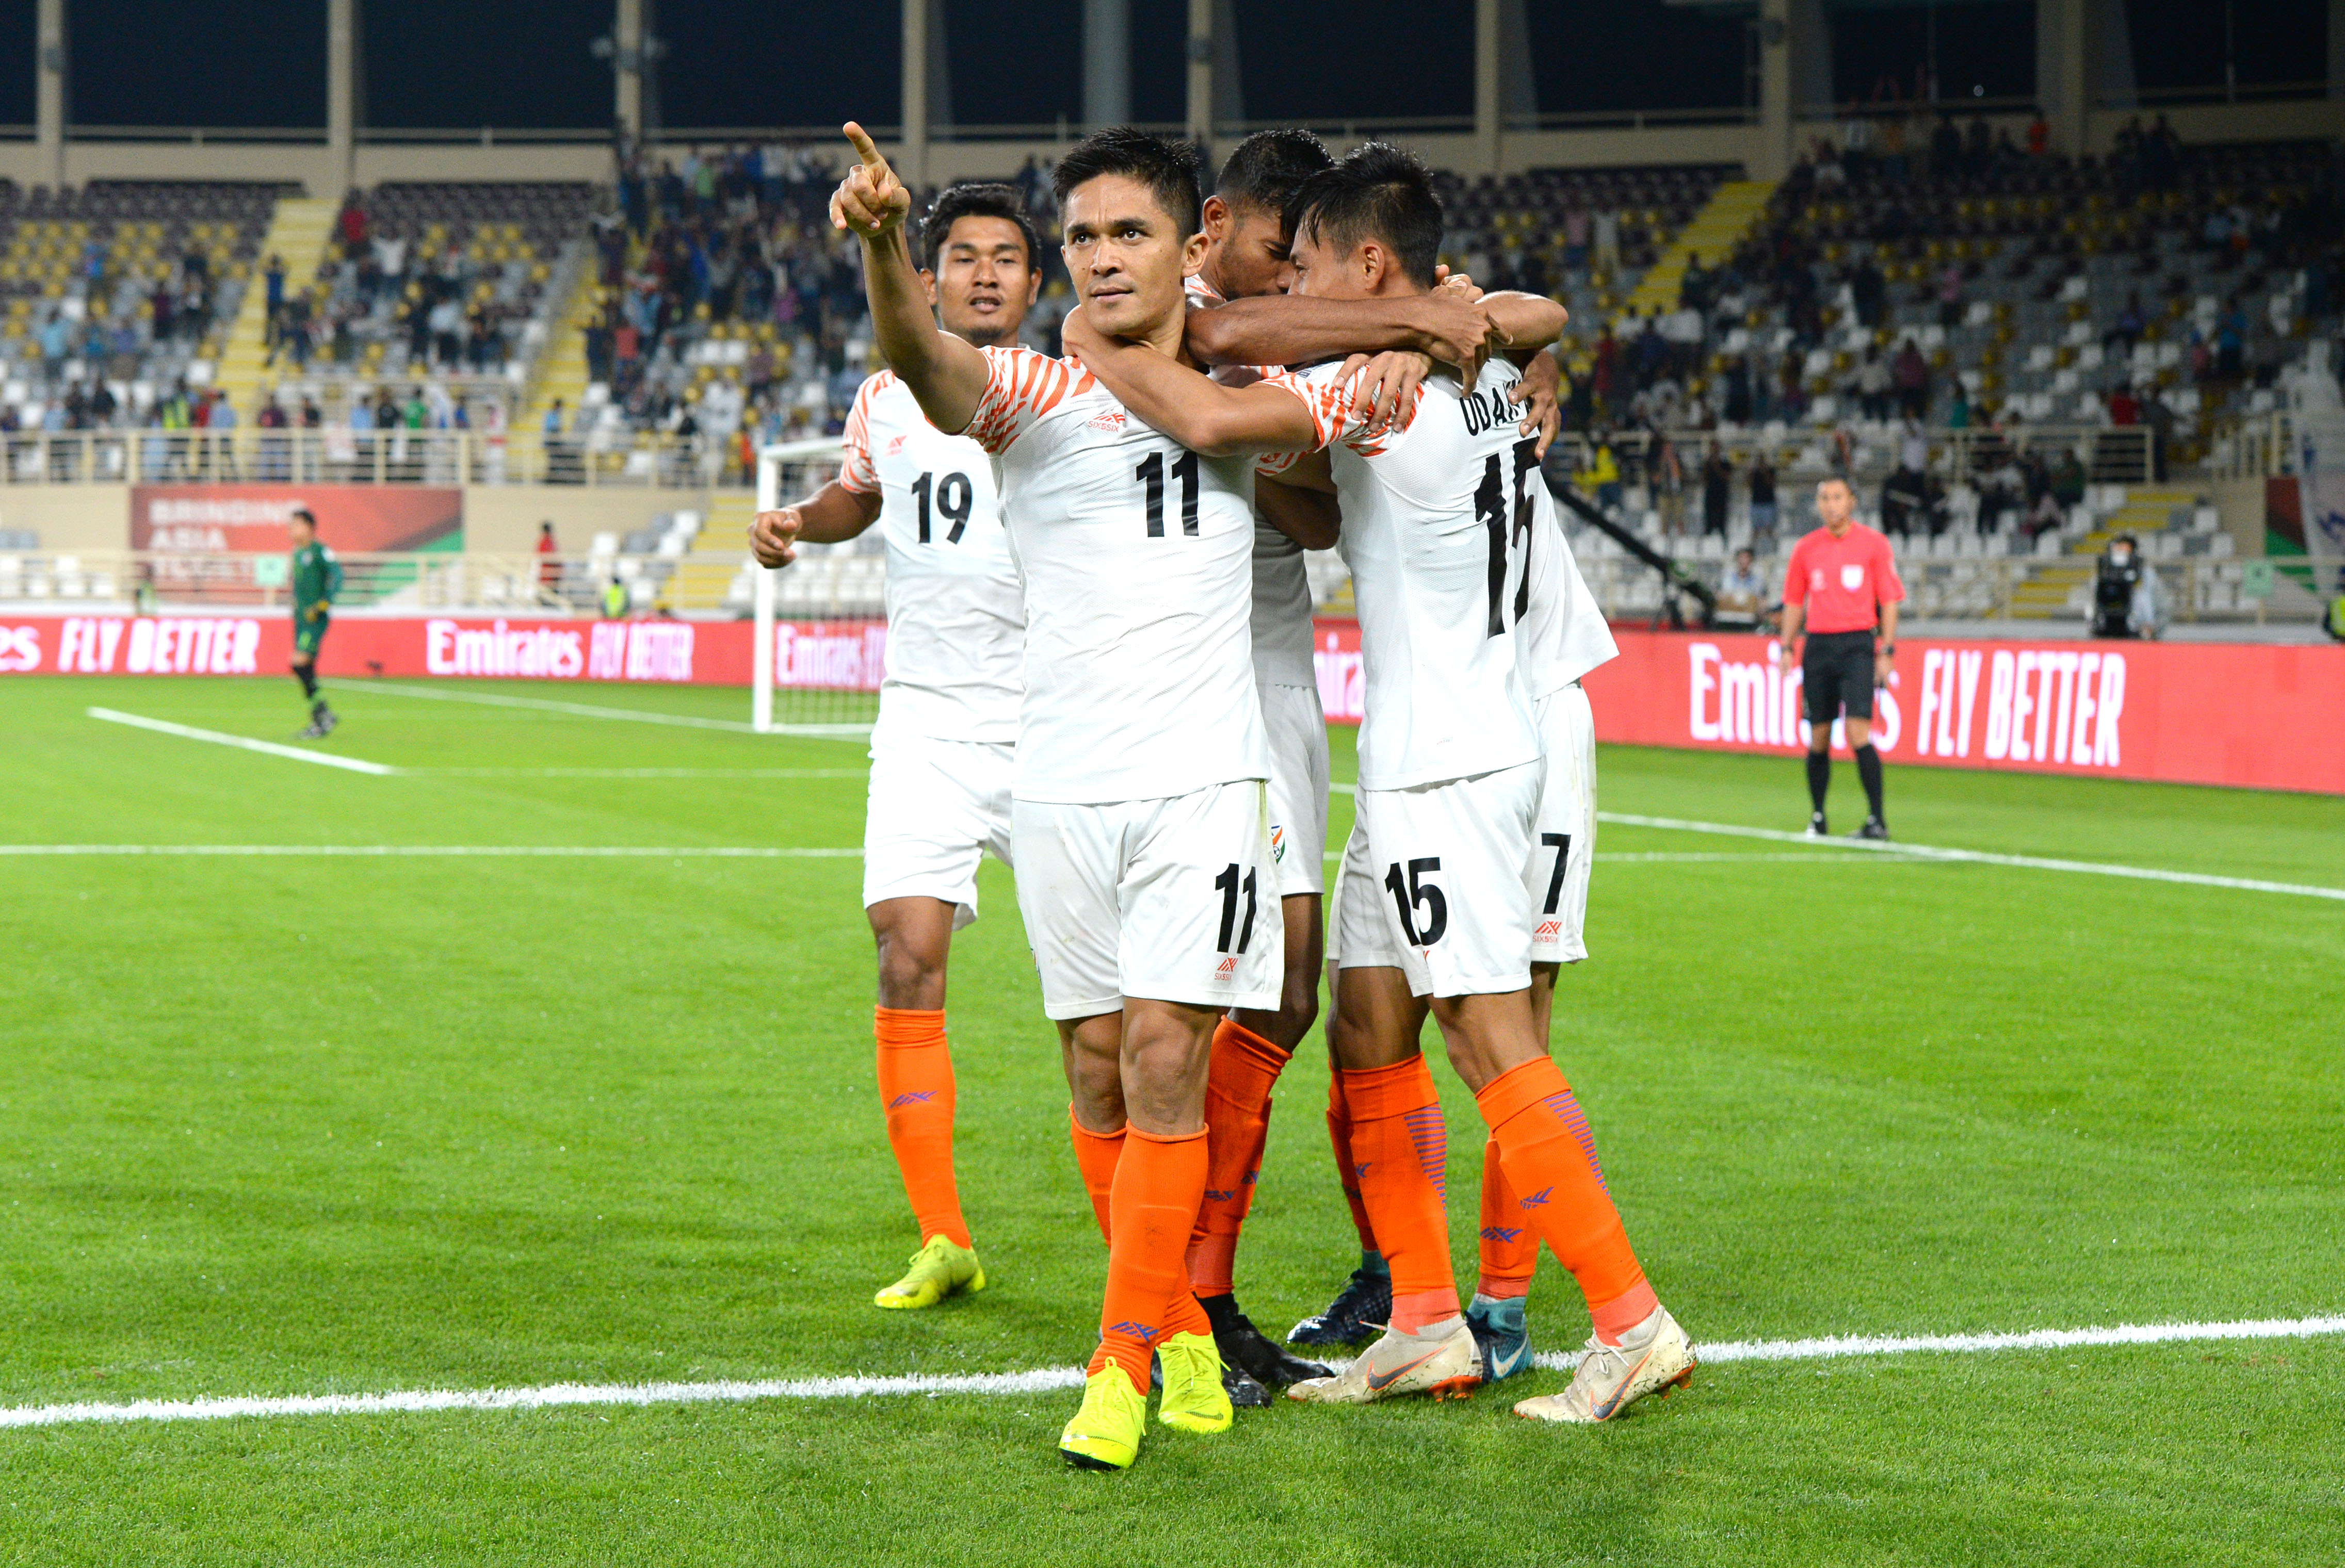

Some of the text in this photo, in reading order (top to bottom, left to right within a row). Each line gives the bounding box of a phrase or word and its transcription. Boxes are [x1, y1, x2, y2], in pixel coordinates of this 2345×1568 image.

[1088, 420, 1120, 432] SIX5SIX
[912, 471, 972, 545] 19
[1137, 451, 1199, 537] 11
[149, 527, 228, 550] ASIA
[1475, 437, 1541, 639] 15
[58, 618, 123, 673] FLY
[127, 618, 260, 674] BETTER
[426, 619, 583, 677] Emirates
[1689, 641, 2127, 767] Emirs FLY BETTER
[1215, 863, 1257, 954] 11
[1384, 857, 1447, 946] 15
[1541, 833, 1572, 914] 7
